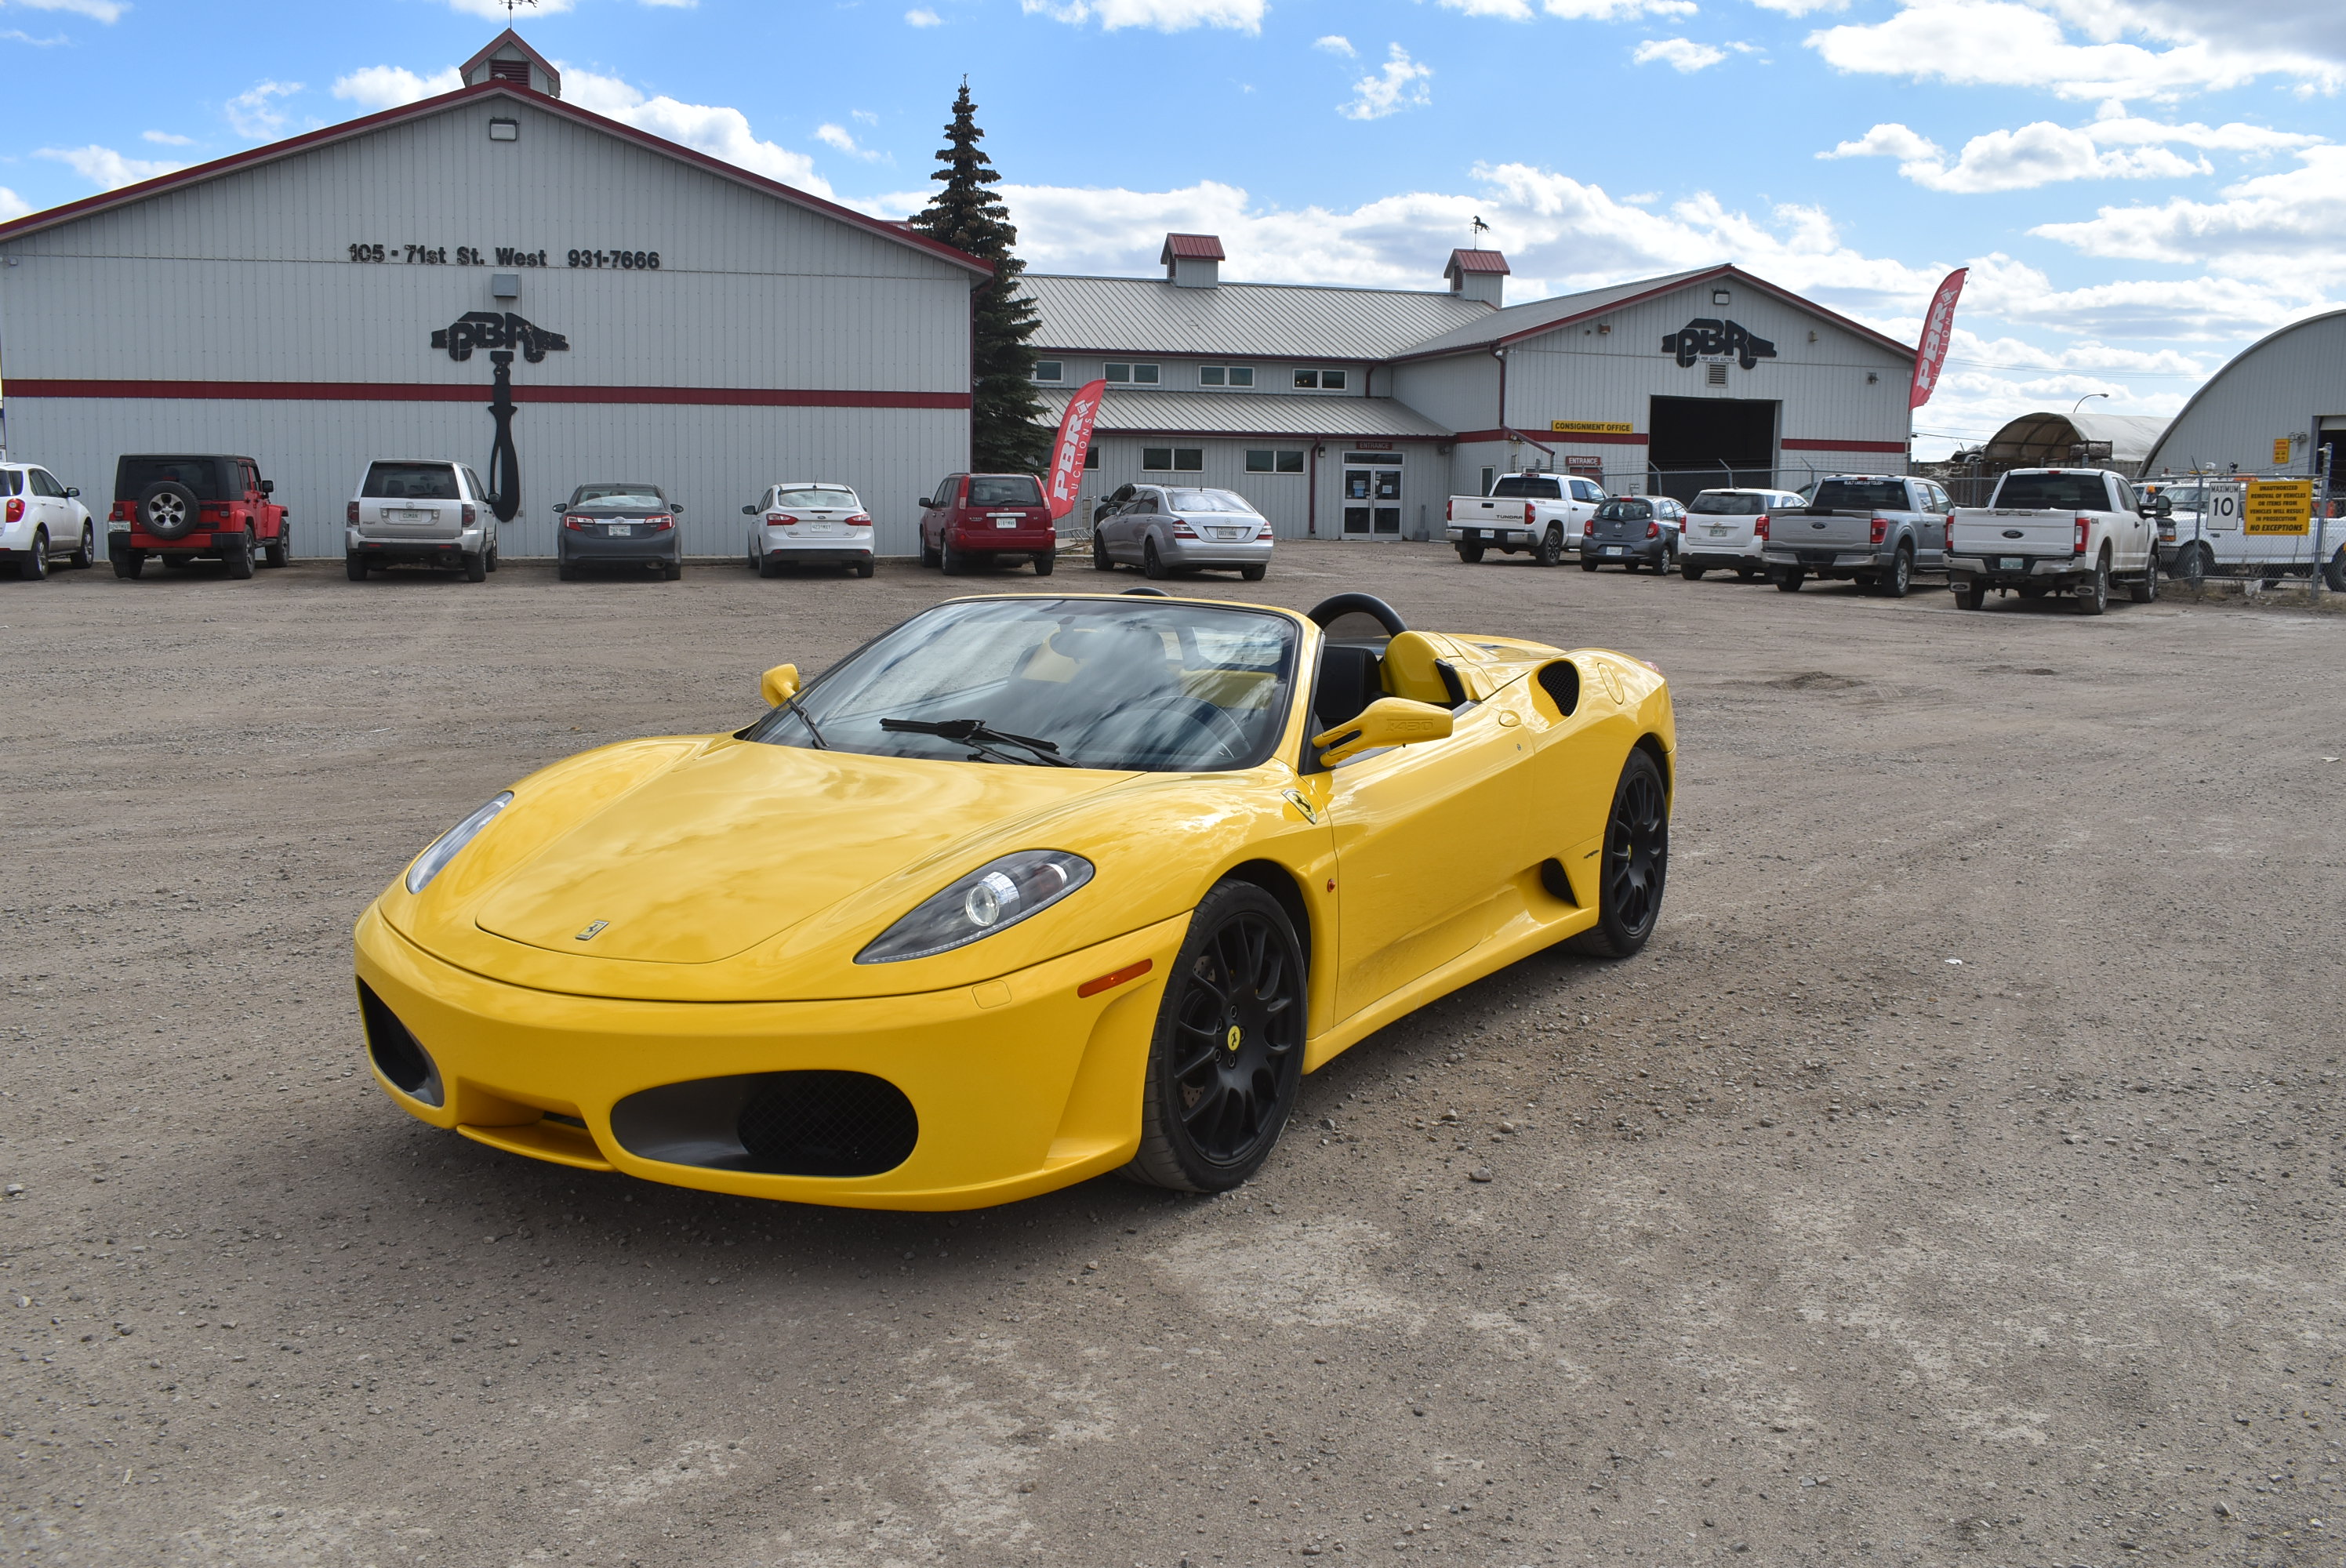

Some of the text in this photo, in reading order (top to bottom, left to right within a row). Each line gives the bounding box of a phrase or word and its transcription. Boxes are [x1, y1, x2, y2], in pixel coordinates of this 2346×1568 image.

[348, 243, 384, 263] 105
[405, 244, 446, 264] 71st
[457, 246, 485, 265] St.
[496, 247, 547, 267] West
[568, 249, 660, 269] 931-7666
[448, 311, 546, 363] PBR
[1676, 318, 1757, 369] PBR
[1917, 303, 1947, 390] PBR
[1054, 414, 1084, 502] PBR
[1070, 418, 1092, 501] AUCTIONS
[2213, 497, 2234, 516] 10
